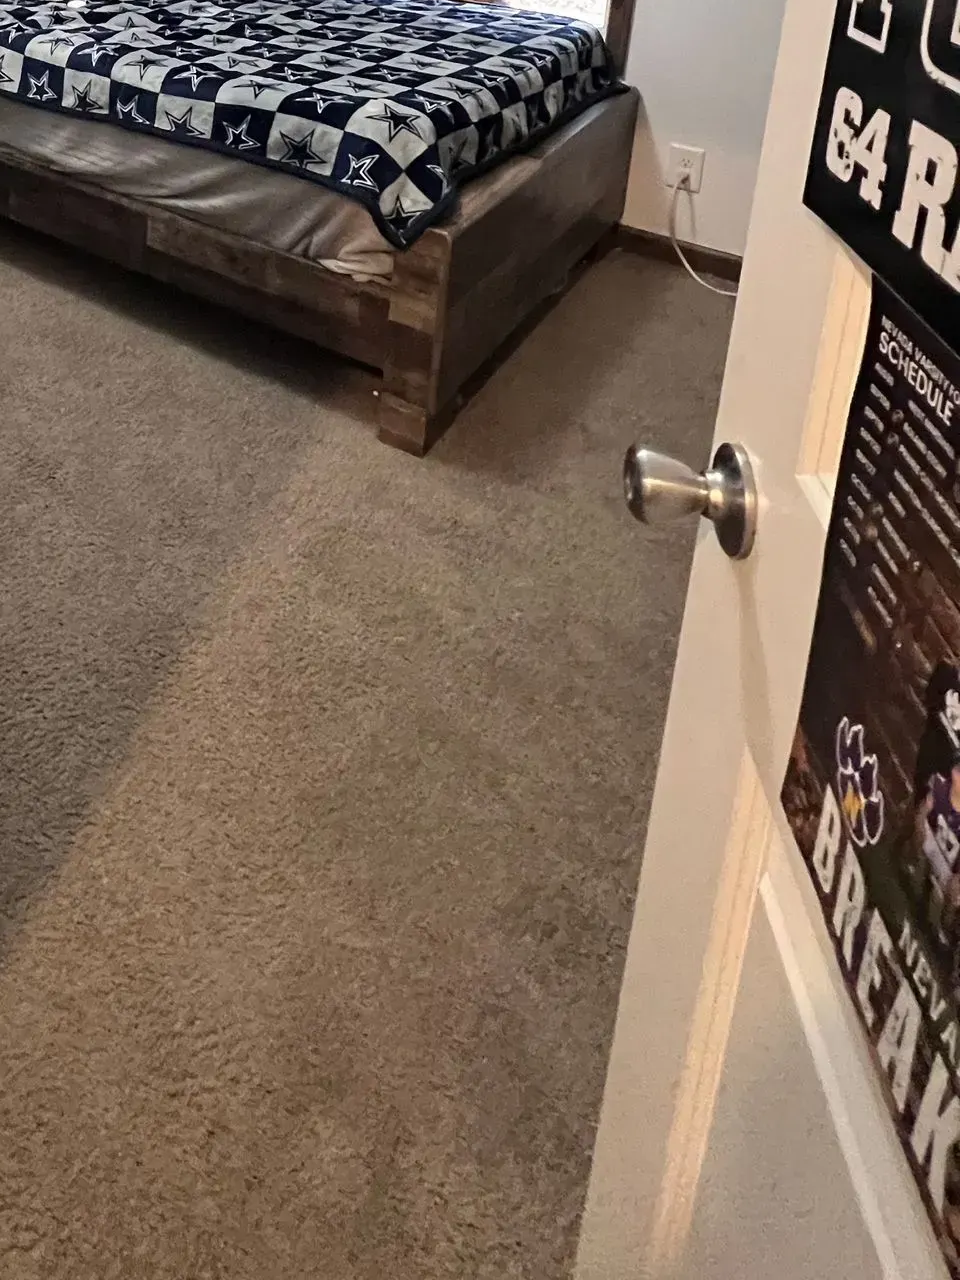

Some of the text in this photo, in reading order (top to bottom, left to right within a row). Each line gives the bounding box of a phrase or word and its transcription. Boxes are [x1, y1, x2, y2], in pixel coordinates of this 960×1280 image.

[826, 86, 891, 210] 64
[878, 330, 955, 427] SCHEDULE
[898, 918, 960, 1080] NEVA
